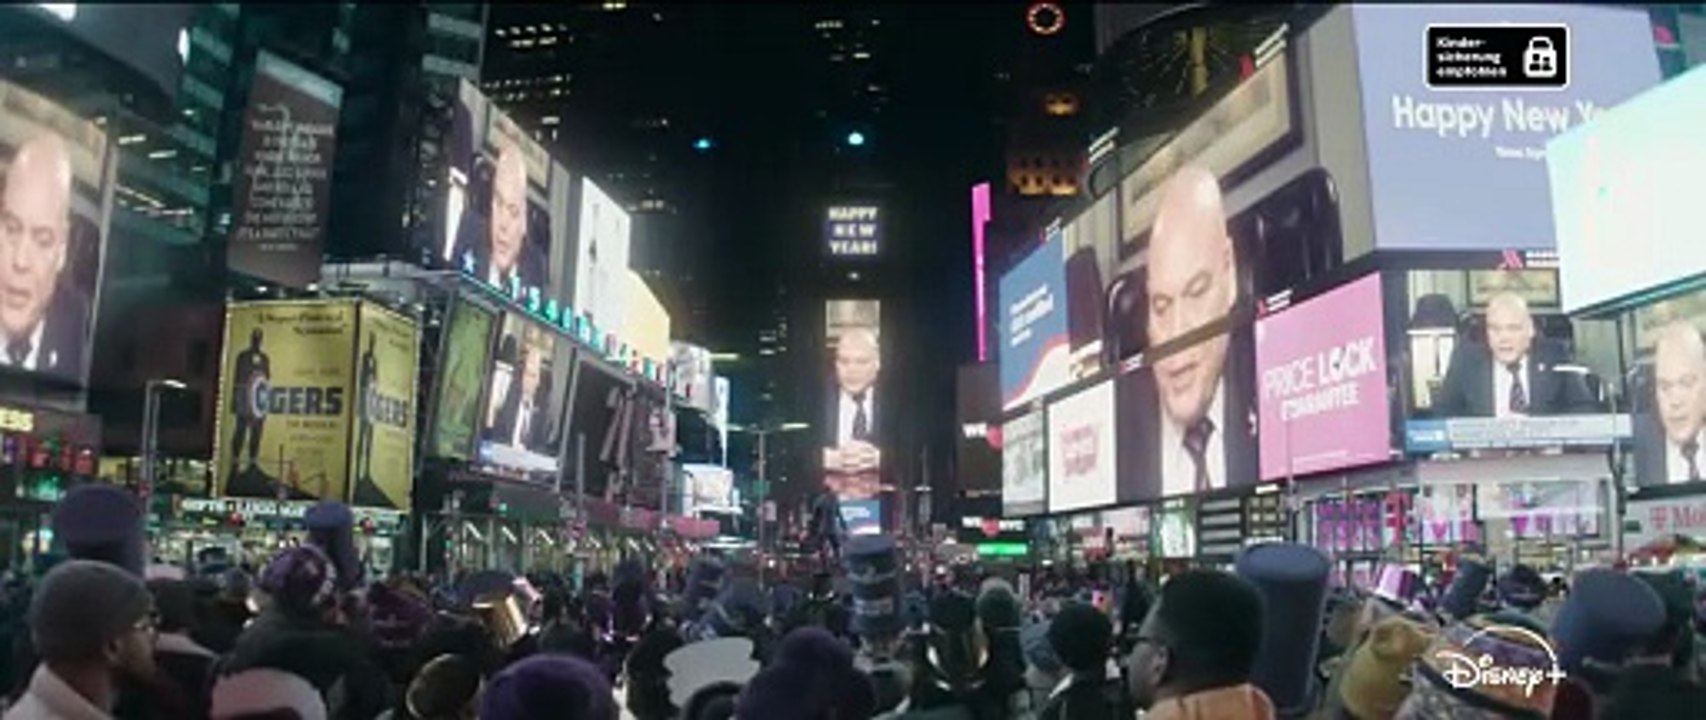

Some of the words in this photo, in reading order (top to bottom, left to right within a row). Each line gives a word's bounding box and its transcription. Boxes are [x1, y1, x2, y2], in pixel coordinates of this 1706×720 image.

[1392, 94, 1495, 138] Happy
[1501, 97, 1568, 132] New
[828, 205, 877, 220] HAPPY
[833, 223, 877, 238] NEW
[828, 239, 877, 255] YEAR!
[1264, 356, 1315, 398] PRICE
[1318, 337, 1377, 386] LOCK
